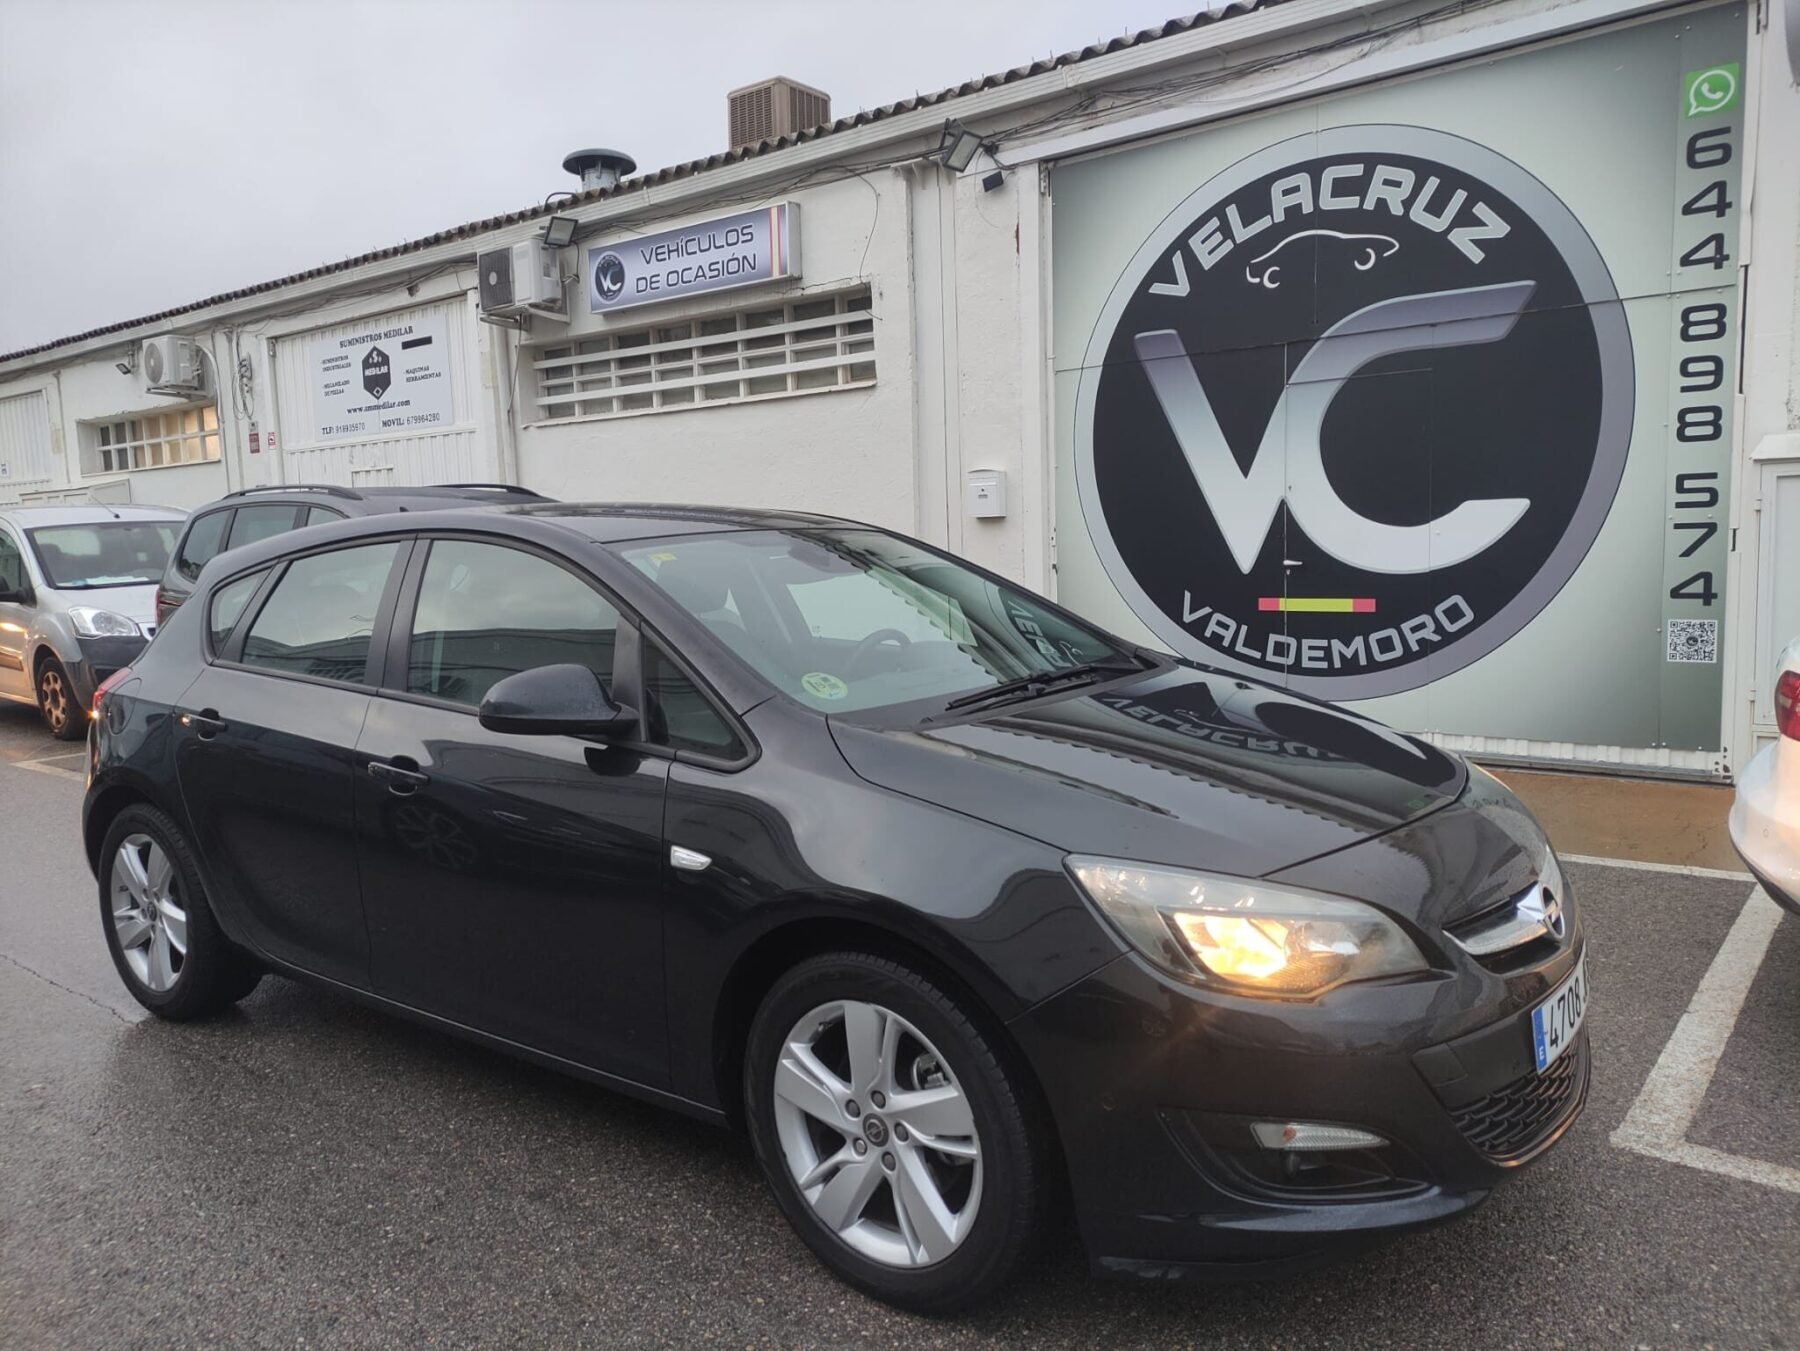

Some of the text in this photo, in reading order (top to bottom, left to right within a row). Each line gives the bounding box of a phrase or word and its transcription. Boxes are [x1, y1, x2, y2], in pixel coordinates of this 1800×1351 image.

[640, 224, 754, 265] VEHÍCULOS
[1148, 163, 1511, 297] VELACRUZ
[636, 252, 757, 294] DE OCASIÓN
[339, 325, 414, 349] SUMINISTROS MEDILAR
[364, 366, 389, 376] MEDILAR
[1669, 126, 1733, 607] 644 898 574
[1133, 280, 1538, 574] VC
[1184, 589, 1475, 669] VALDEMORO
[1549, 976, 1582, 1049] 4708
